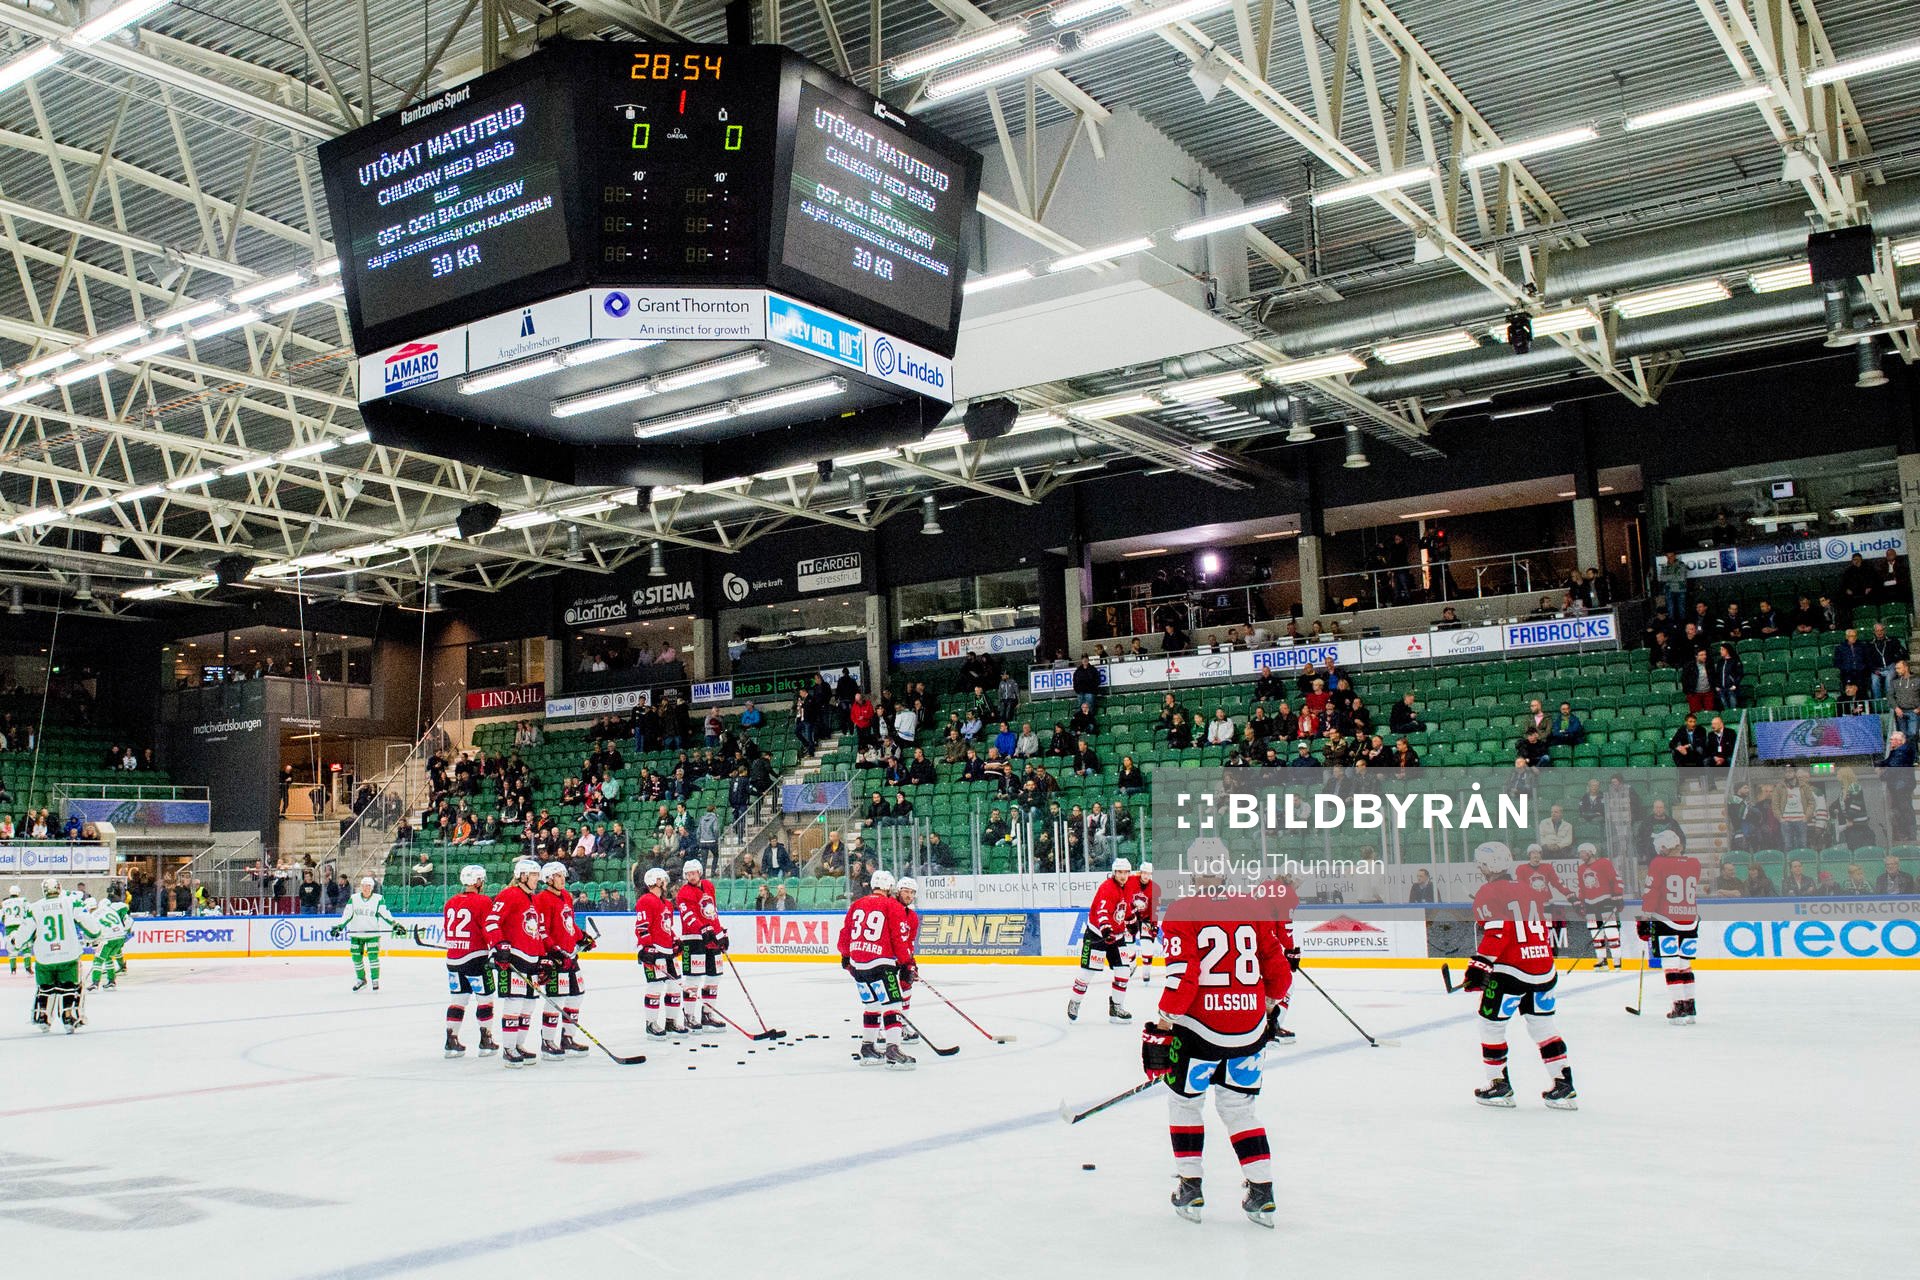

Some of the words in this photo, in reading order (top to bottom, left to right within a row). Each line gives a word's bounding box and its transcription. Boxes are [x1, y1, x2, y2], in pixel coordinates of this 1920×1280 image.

[631, 53, 722, 80] 28:54
[401, 96, 445, 126] Rantzows
[444, 85, 471, 108] Sport
[358, 143, 424, 186] UTÖKAT
[427, 103, 527, 159] MATUTBUD
[632, 123, 650, 149] 0
[725, 125, 743, 150] 0
[814, 107, 875, 153] UTÖKAT
[876, 138, 950, 192] MATUTBUD
[377, 168, 442, 206] CHILIKORV
[444, 156, 474, 181] MED
[475, 141, 516, 168] BRÖD
[825, 146, 883, 185] CHILIKORV
[408, 212, 437, 235] OCH
[438, 180, 525, 226] BACON-KORV
[464, 219, 487, 235] OCH
[488, 195, 553, 229] KLACKBAREN
[844, 197, 869, 220] OCH
[870, 207, 936, 251] BACON-KORV
[431, 253, 454, 278] 30
[456, 244, 482, 270] KR
[852, 246, 872, 272] 30
[874, 255, 893, 281] KR
[637, 298, 680, 314] Grant
[682, 297, 750, 314] Thornton
[640, 324, 654, 335] An
[657, 323, 695, 335] instinct
[697, 323, 712, 335] for
[714, 324, 751, 337] growth
[385, 352, 439, 384] LAMARO
[401, 376, 419, 388] Service
[419, 372, 439, 384] Partner
[898, 352, 944, 388] Lindab
[1758, 550, 1819, 566] ARKITEKTER
[1850, 537, 1902, 554] Lindab
[645, 581, 695, 605] STENA
[768, 578, 783, 588] kraft
[1005, 634, 1037, 647] Lindab
[1509, 619, 1610, 645] FRIBROCKS
[940, 640, 960, 657] LM
[960, 636, 986, 647] BYGG
[1253, 645, 1338, 670] FRIBROCKS
[693, 684, 711, 698] HNA
[712, 682, 731, 695] HNA
[735, 682, 762, 696] akea
[1033, 666, 1108, 690] FRIBRS
[480, 687, 542, 708] LINDAHL
[979, 882, 997, 893] DIN
[1666, 874, 1697, 905] 96
[1476, 904, 1492, 920] 14
[1809, 901, 1920, 915] CONTRACTOR
[43, 914, 65, 942] 31
[447, 908, 472, 938] 22
[756, 915, 829, 945] MAXI
[851, 908, 886, 942] 39
[1507, 900, 1545, 943] 14
[137, 929, 234, 944] INTERSPORT
[1163, 936, 1182, 958] 28
[1302, 936, 1389, 947] HVP-GRUPPEN.SE
[1724, 918, 1920, 958] areco
[756, 945, 769, 954] ICA
[769, 945, 830, 955] STORMARKNAD
[919, 948, 956, 956] SCHAKT
[966, 947, 1020, 956] TRANSPORT
[1197, 924, 1261, 987] 28
[1520, 945, 1550, 960] MEECH
[1204, 992, 1258, 1011] OLSSON
